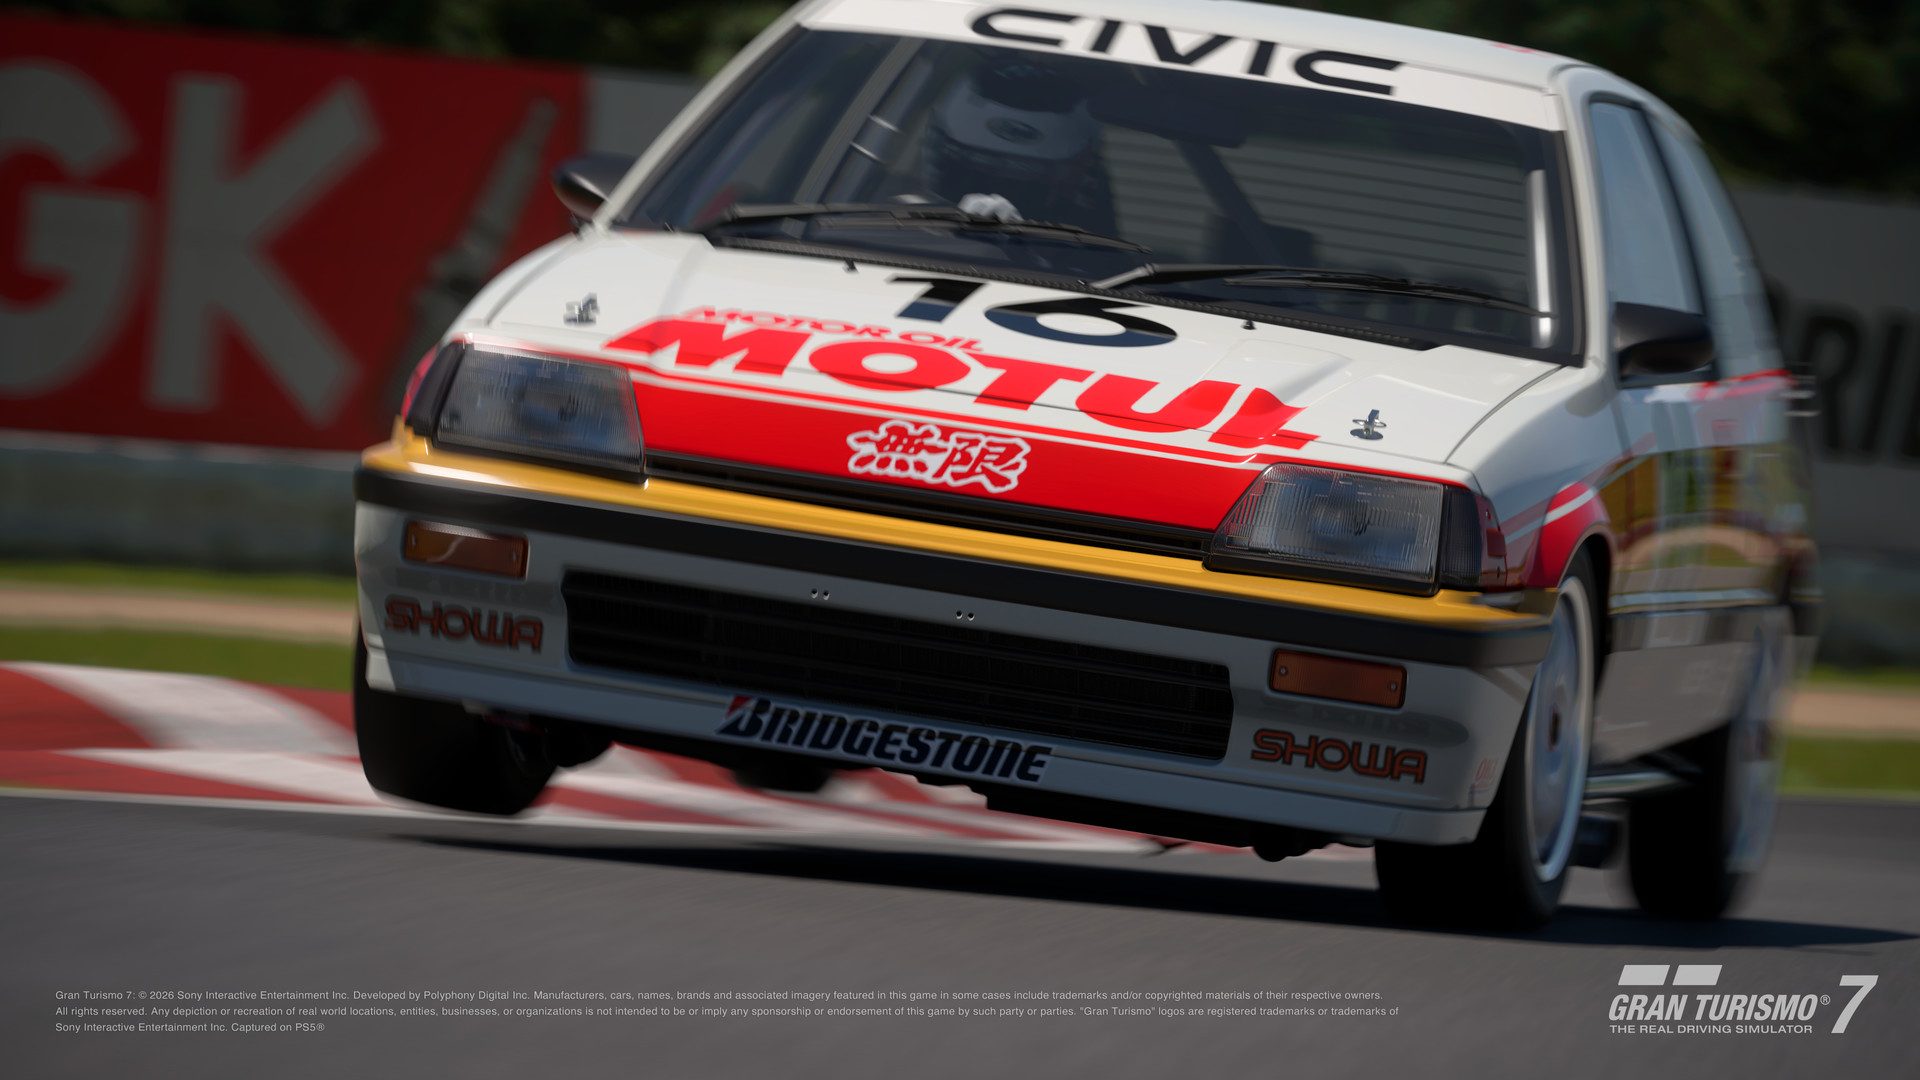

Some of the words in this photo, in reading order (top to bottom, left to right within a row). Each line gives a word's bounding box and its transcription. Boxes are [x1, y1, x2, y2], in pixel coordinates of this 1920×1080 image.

[970, 9, 1405, 95] CIVIC
[0, 57, 382, 425] GK
[687, 306, 892, 338] MOTOR
[899, 330, 984, 352] OIL
[890, 277, 1178, 348] 16
[603, 318, 1320, 449] MOTUL
[847, 420, 1031, 493] 無限
[385, 594, 543, 655] SHOWA
[714, 696, 1053, 783] BRIDGESTONE
[1251, 728, 1428, 783] SHOWA
